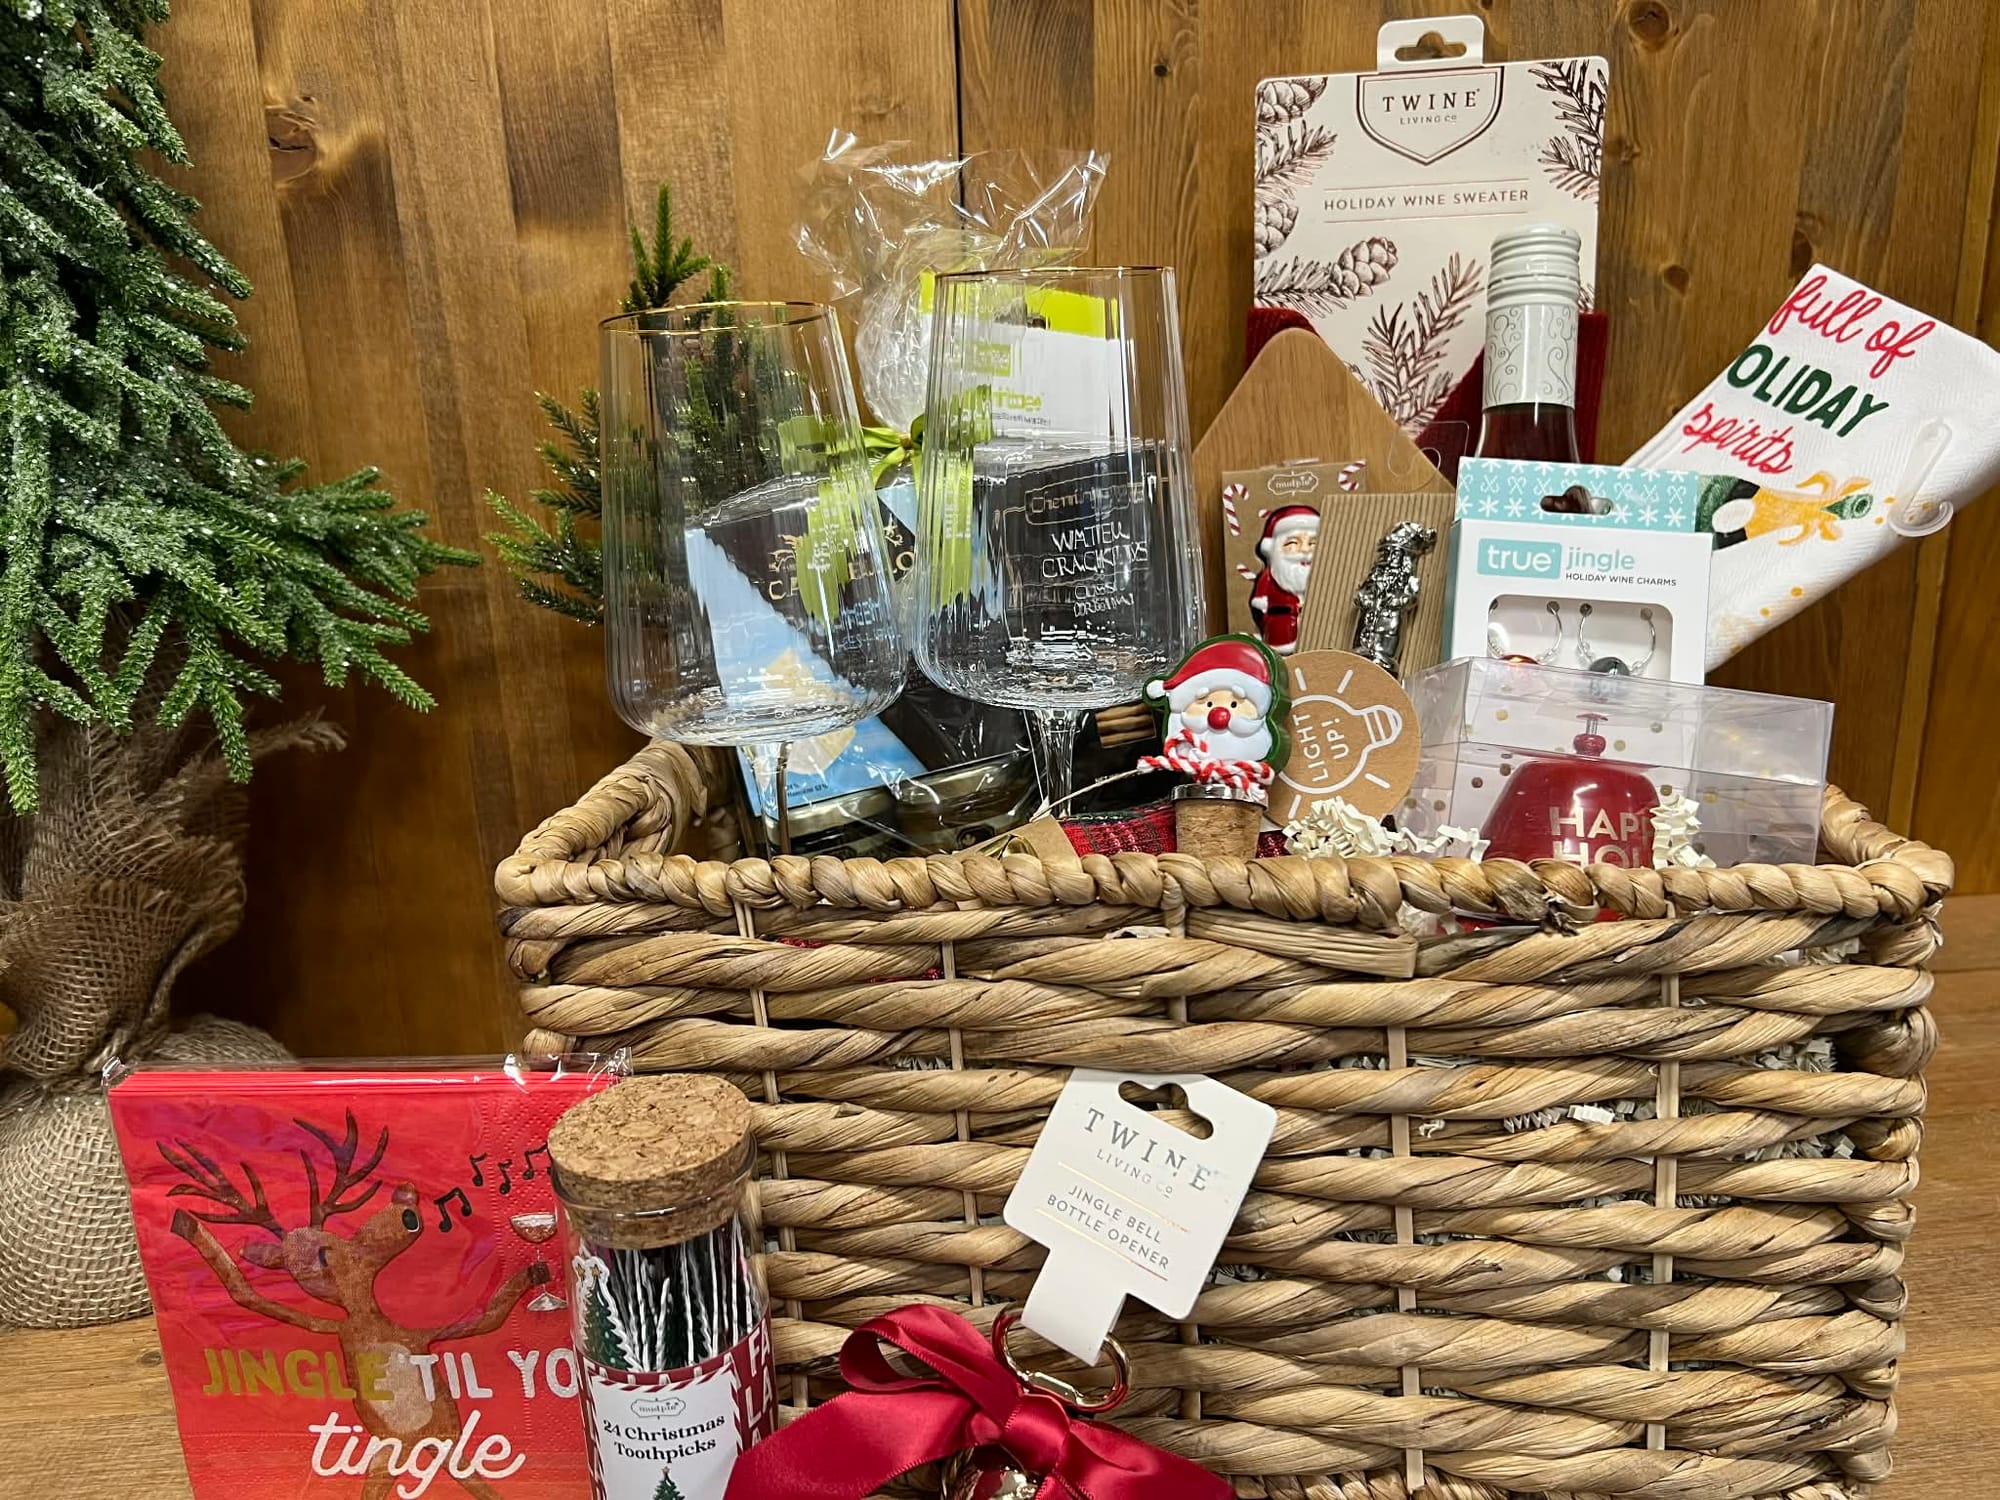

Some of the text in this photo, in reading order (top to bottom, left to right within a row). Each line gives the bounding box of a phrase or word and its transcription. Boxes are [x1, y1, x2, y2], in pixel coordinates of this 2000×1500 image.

[1382, 90, 1478, 112] TWINE
[1399, 115, 1441, 125] LIVING
[1324, 189, 1529, 211] HOLIDAY WINE SWEATER
[1768, 275, 1936, 379] full of
[1682, 402, 1793, 474] spirits
[1487, 545, 1635, 572] true jingle
[1565, 573, 1677, 587] HOLIDAY WINE CHARMS
[1292, 713, 1329, 782] LIGHT
[1321, 717, 1350, 760] UP!
[1084, 1107, 1211, 1192] TWINE
[1096, 1148, 1152, 1185] LIVING
[1047, 1194, 1169, 1270] BOTTLE OPENER
[1068, 1185, 1161, 1244] JINGLE BELL
[203, 1348, 395, 1400] JINGLE
[624, 1415, 725, 1442] Christmas
[308, 1410, 526, 1500] tingle
[614, 1438, 716, 1464] Toothpicks
